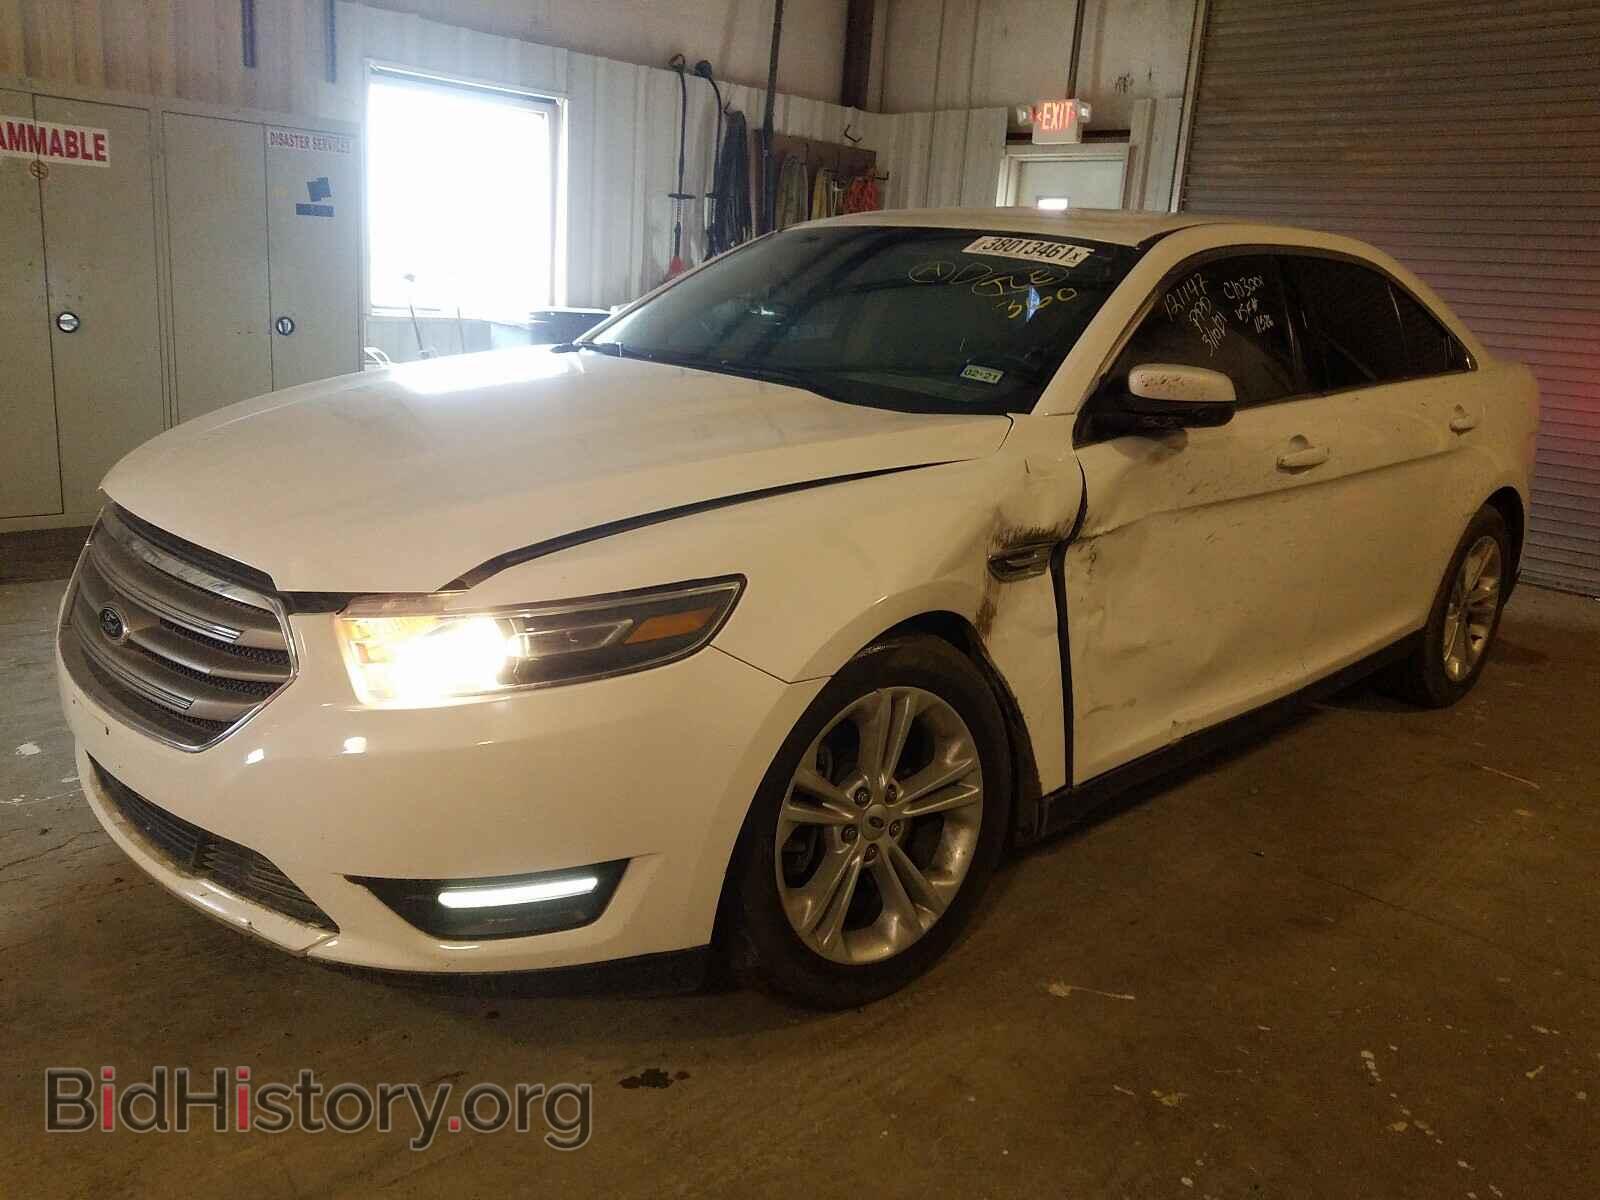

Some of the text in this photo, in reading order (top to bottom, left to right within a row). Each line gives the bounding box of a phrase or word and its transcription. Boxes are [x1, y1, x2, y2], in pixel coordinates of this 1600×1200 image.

[1041, 101, 1073, 130] EXIT
[270, 131, 310, 151] DISASTER
[982, 238, 1072, 260] 38013461
